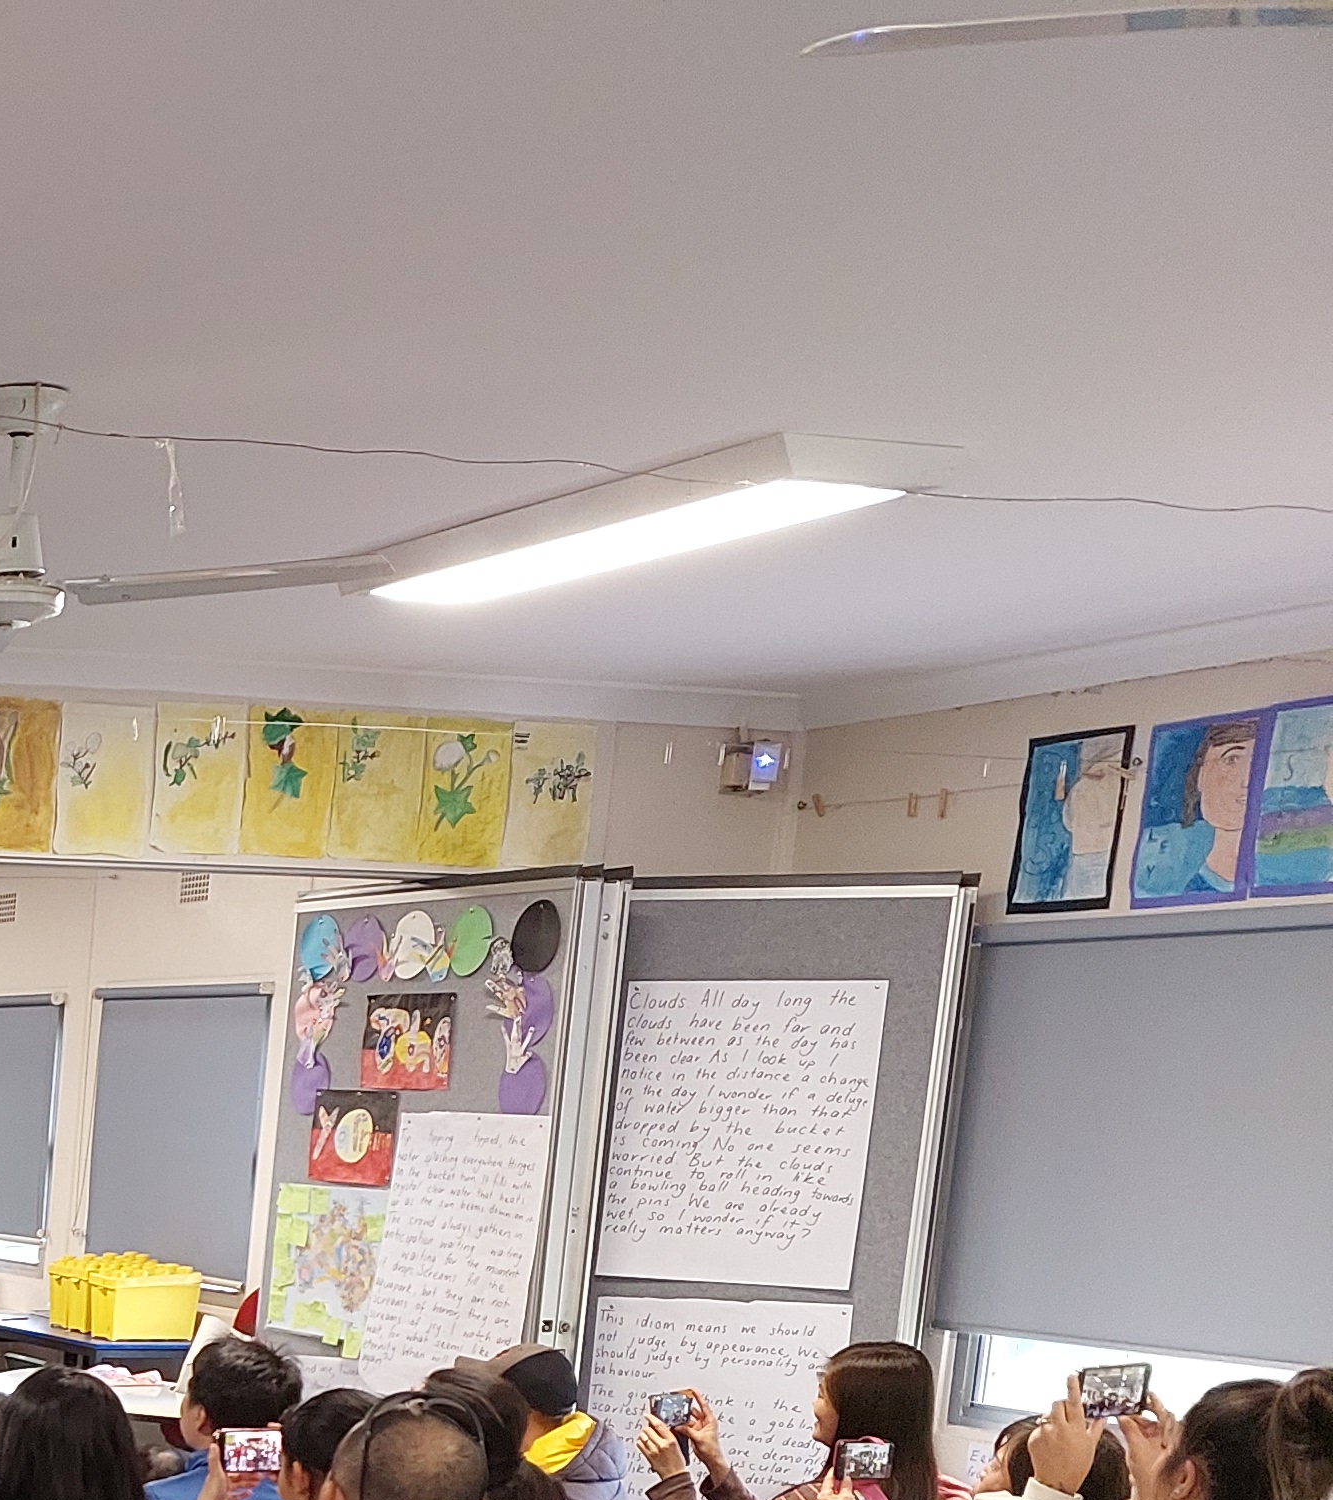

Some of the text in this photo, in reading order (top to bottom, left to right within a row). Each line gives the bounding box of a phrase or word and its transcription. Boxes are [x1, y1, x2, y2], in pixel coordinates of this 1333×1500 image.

[629, 989, 857, 1020] Clouds All day long the
[627, 1014, 856, 1036] clouds have been far and
[625, 1031, 857, 1056] few between as the day has
[623, 1049, 838, 1067] been clear As I look up I
[621, 1067, 870, 1091] notice in the distance a change
[620, 1086, 632, 1096] in
[643, 1084, 662, 1097] the
[671, 1086, 697, 1105] day
[708, 1084, 713, 1097] I
[718, 1088, 772, 1100] wonder
[783, 1088, 799, 1100] if
[826, 1093, 868, 1112] deluge
[616, 1098, 853, 1122] of water bigger than that
[508, 1134, 526, 1146] the
[615, 1119, 845, 1139] dropped by the bucket
[614, 1137, 625, 1146] is
[713, 1137, 734, 1152] No
[747, 1143, 773, 1152] one
[792, 1144, 851, 1157] seems
[428, 1169, 455, 1180] bucket
[689, 1153, 724, 1167] But
[737, 1156, 762, 1169] the
[780, 1159, 833, 1174] clouds
[609, 1166, 826, 1186] continue to roll in like
[609, 1179, 854, 1205] a bowling ball heading towards
[607, 1209, 800, 1228] wet so I wonder if it
[608, 1193, 822, 1226] the pins We are already
[441, 1217, 471, 1237] always
[605, 1223, 811, 1250] really matters anyway?
[446, 1289, 511, 1308] they not
[599, 1309, 816, 1337] This idiom means we should
[598, 1330, 618, 1342] not
[626, 1336, 666, 1348] judge
[680, 1336, 697, 1354] by
[798, 1347, 819, 1359] We
[594, 1362, 657, 1379] behaviour.
[595, 1348, 637, 1359] should
[644, 1353, 680, 1370] judge
[694, 1355, 709, 1369] by
[721, 1356, 798, 1376] personality
[591, 1383, 614, 1398] The
[745, 1400, 755, 1408] is
[773, 1400, 802, 1413] the
[592, 1402, 647, 1416] scariest
[749, 1418, 756, 1426] a
[747, 1435, 821, 1457] and deadly
